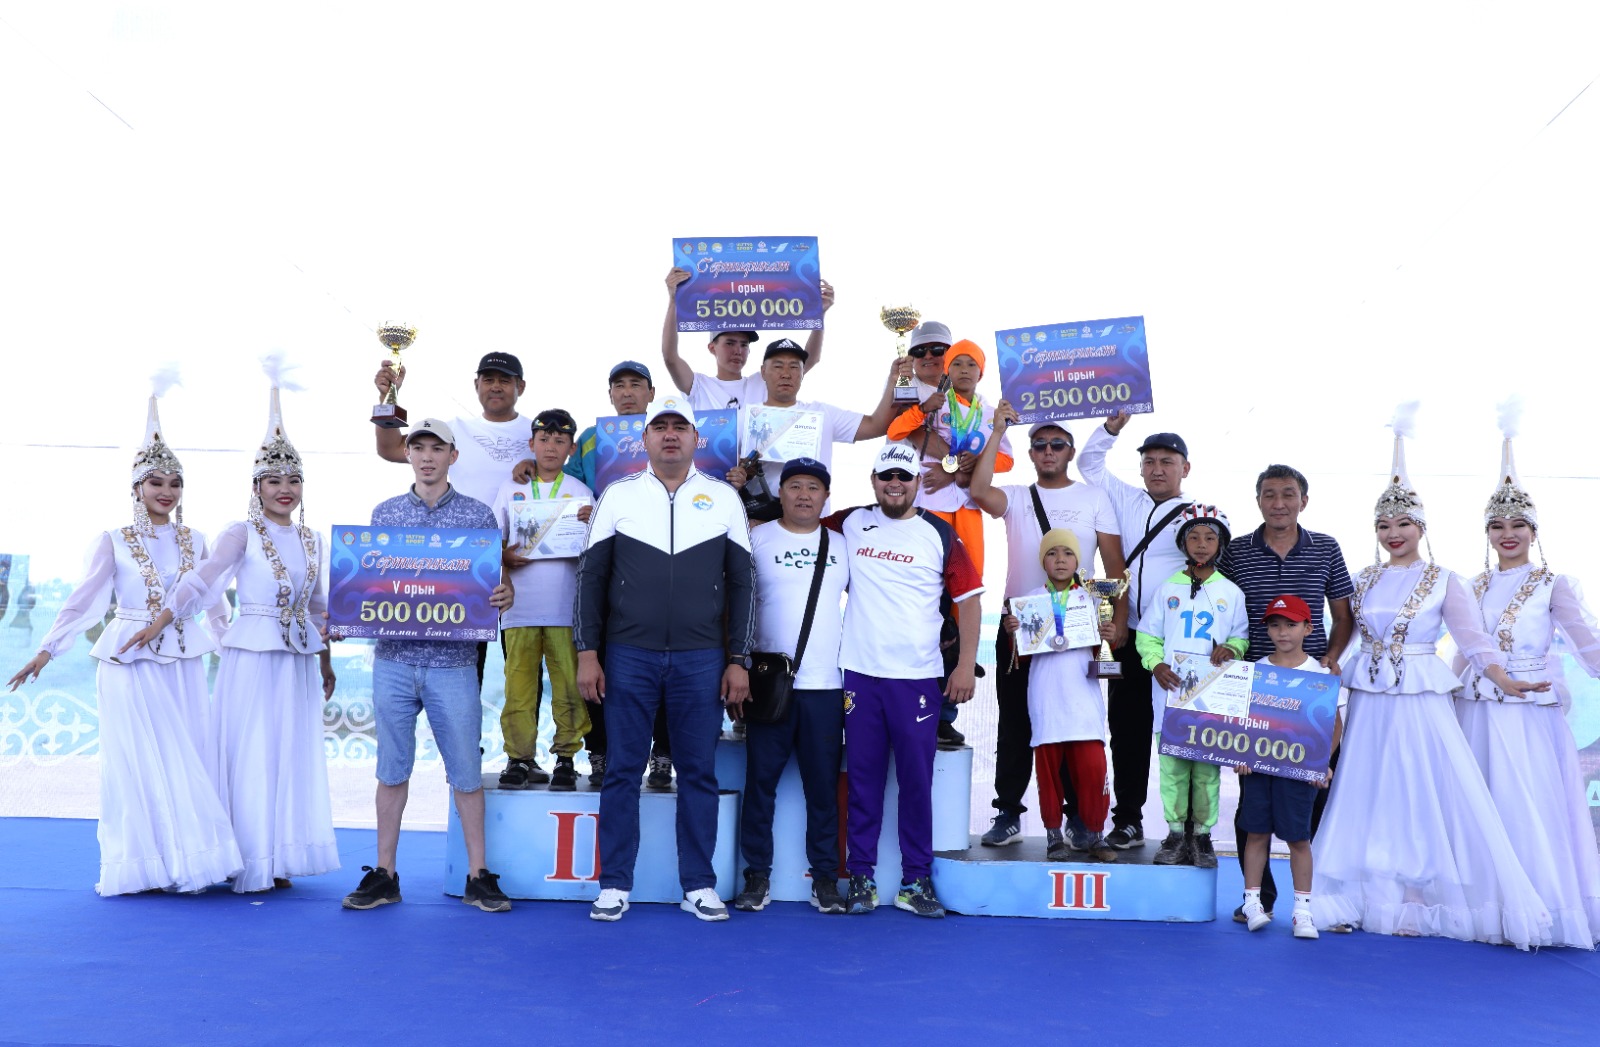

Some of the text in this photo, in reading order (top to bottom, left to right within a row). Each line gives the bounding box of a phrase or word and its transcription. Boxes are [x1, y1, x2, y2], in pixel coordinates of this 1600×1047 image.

[696, 257, 790, 278] Сертификат
[737, 284, 765, 297] орын
[696, 298, 803, 318] 5 500 000
[1021, 344, 1117, 369] Сертификат
[1053, 370, 1095, 384] III орын
[1021, 383, 1131, 410] 2 500 000
[880, 446, 914, 464] Madrid
[361, 550, 471, 578] Сертификат
[392, 580, 435, 599] V орын
[360, 601, 466, 624] 500 000
[373, 627, 418, 637] Аламан
[1180, 610, 1214, 641] 12
[1238, 717, 1270, 731] орын
[1186, 725, 1305, 764] 1 000 000
[1049, 872, 1109, 908] III
